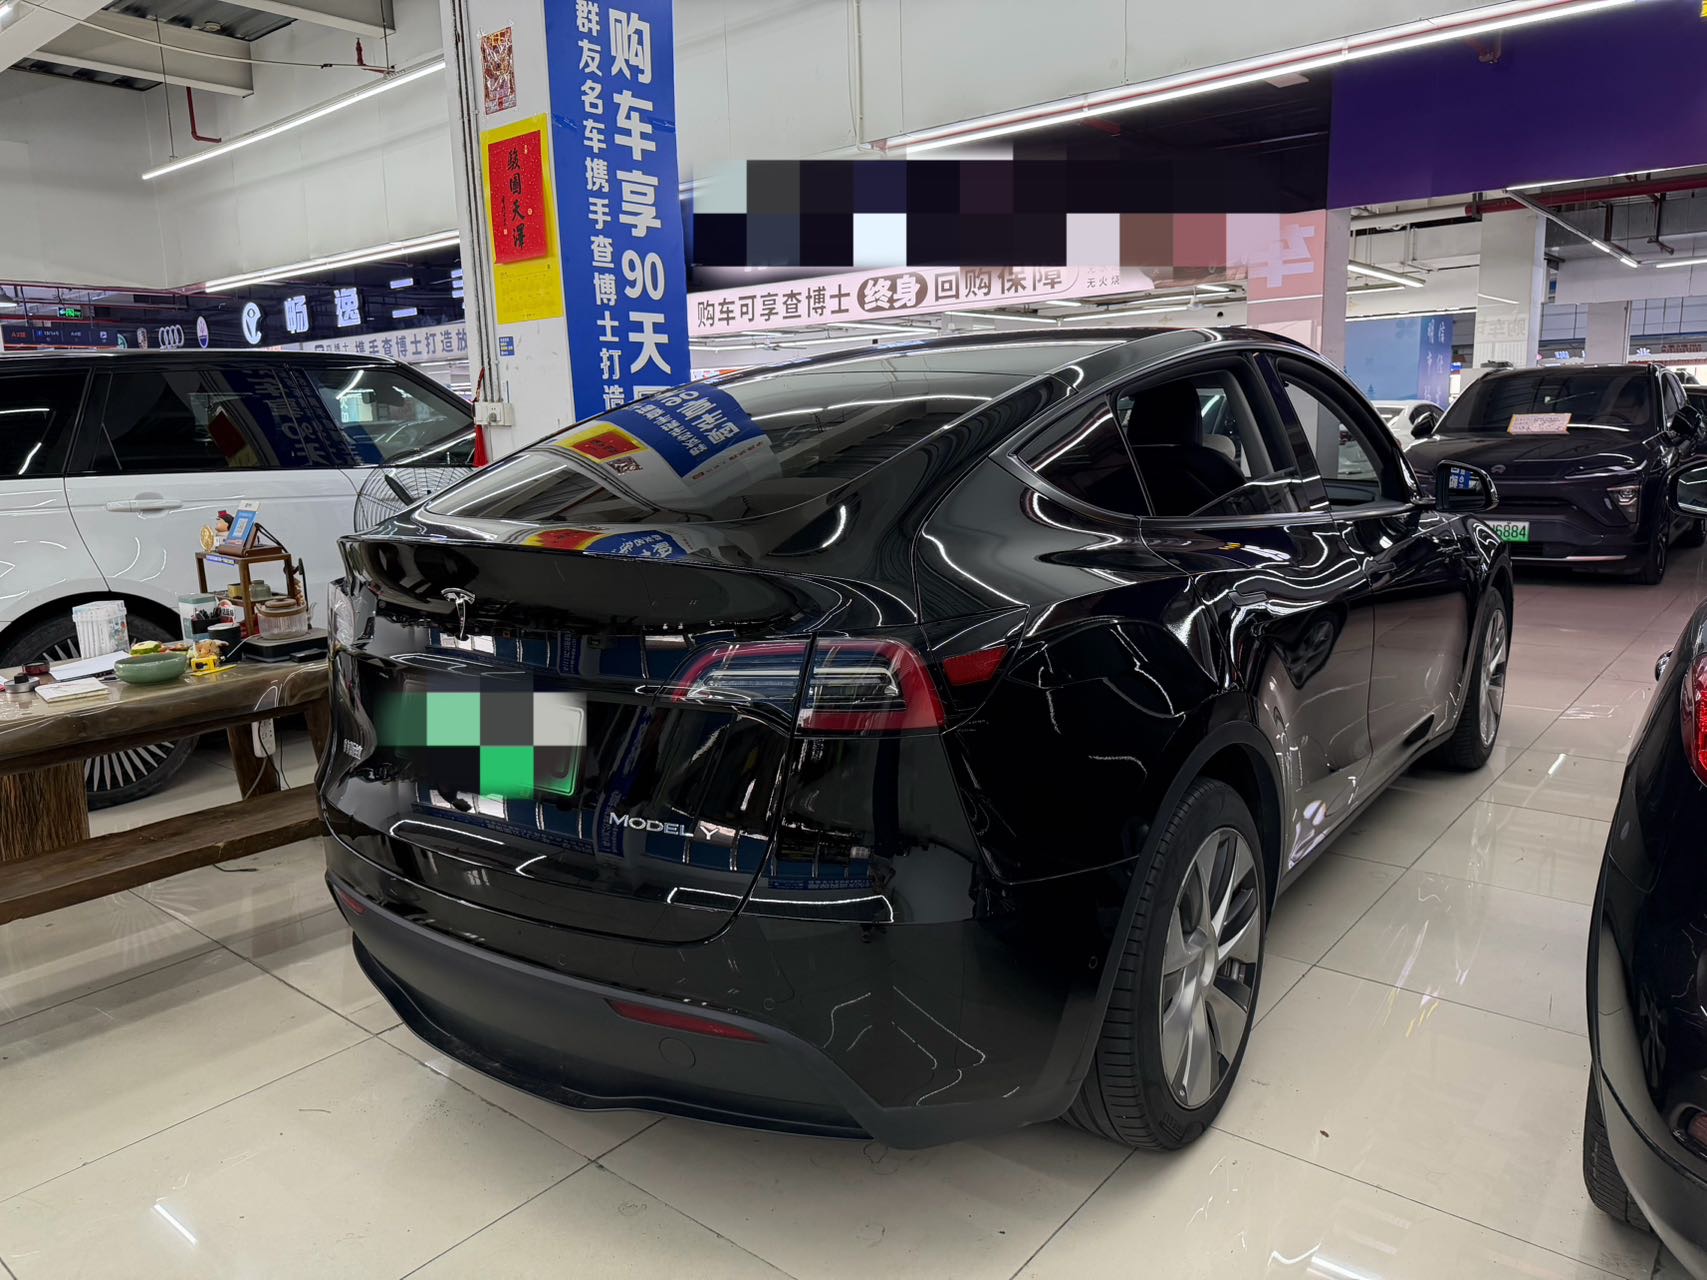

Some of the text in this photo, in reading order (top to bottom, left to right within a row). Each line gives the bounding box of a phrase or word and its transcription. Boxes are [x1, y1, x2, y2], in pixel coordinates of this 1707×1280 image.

[697, 266, 1063, 328] 购车可享查博士 终身 回购保障
[609, 812, 694, 837] MODEL
[699, 825, 719, 841] Y
